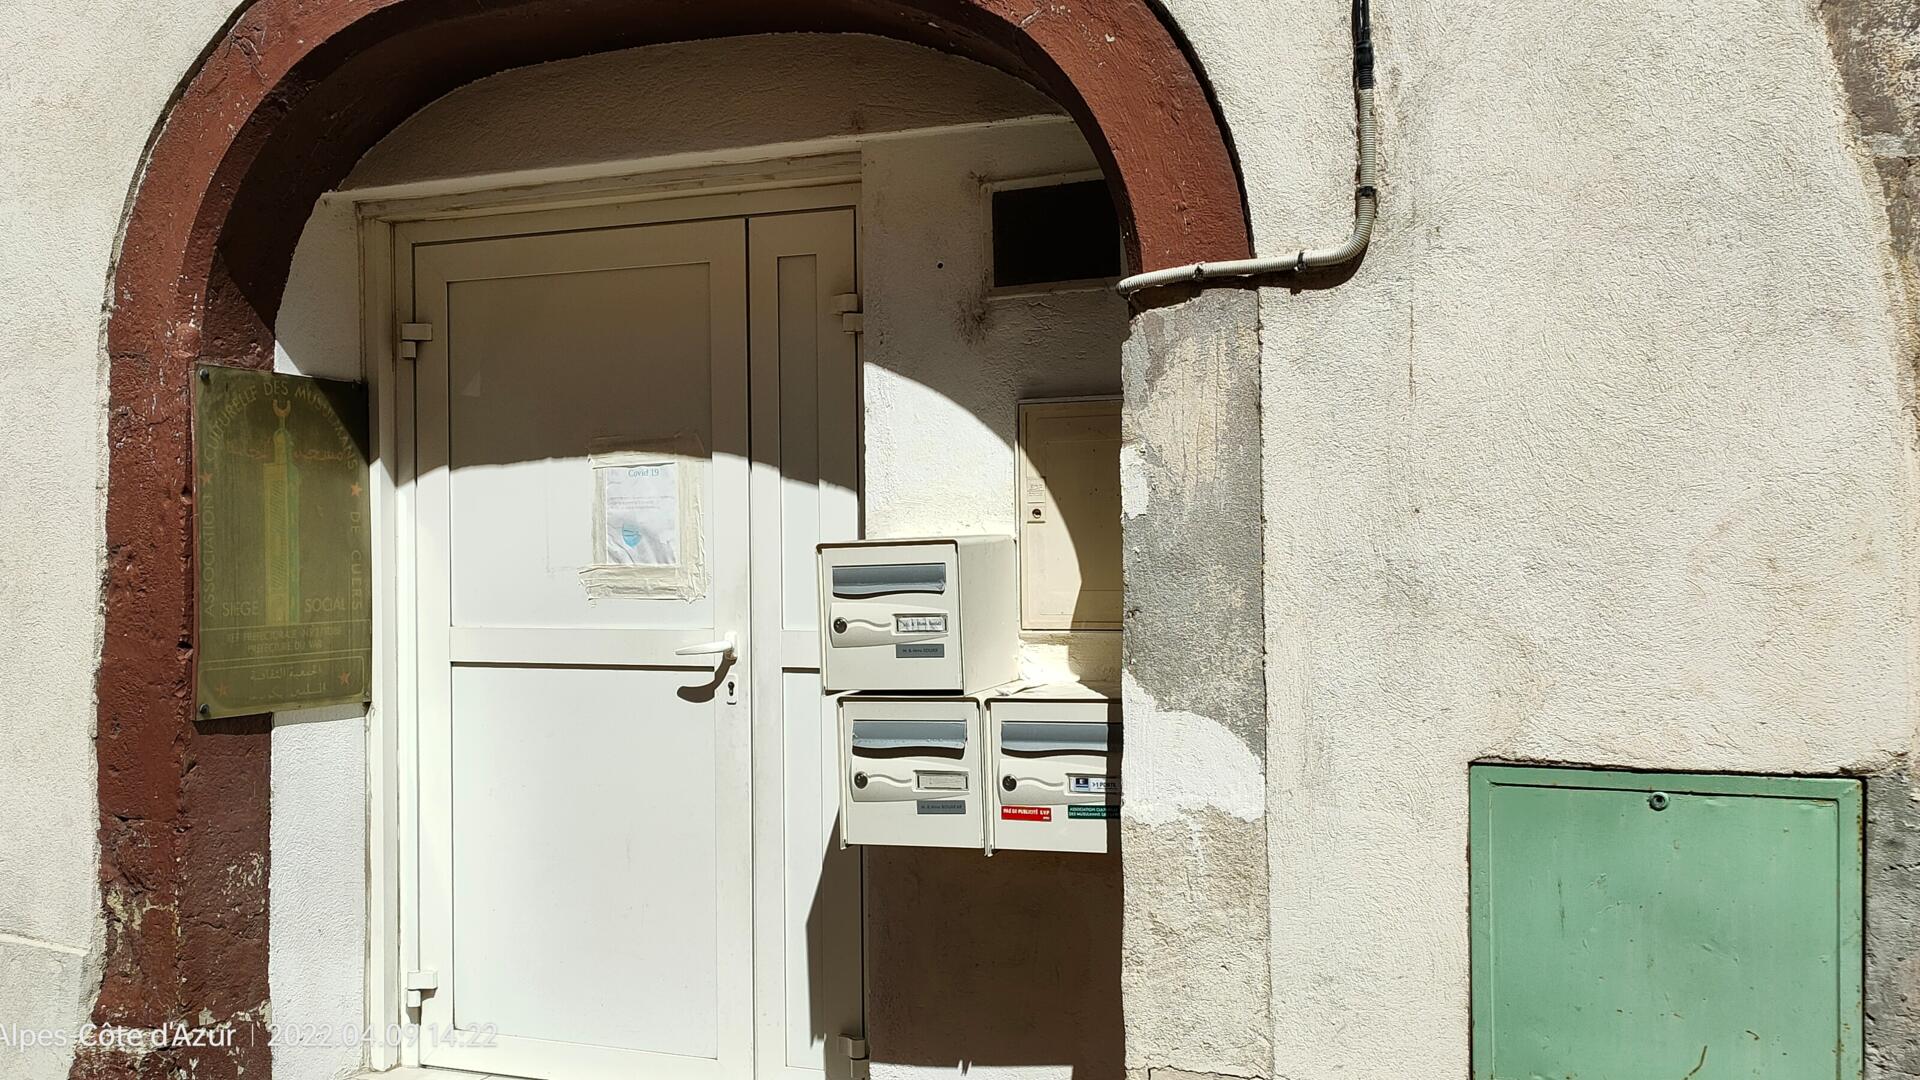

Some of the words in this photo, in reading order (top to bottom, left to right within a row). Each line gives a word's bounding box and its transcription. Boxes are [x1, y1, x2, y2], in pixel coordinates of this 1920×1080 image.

[263, 380, 289, 397] DES
[204, 384, 258, 463] CULTURELLE
[628, 467, 649, 478] Covid
[651, 467, 659, 477] 19
[351, 512, 361, 534] DE
[202, 495, 216, 617] ASSOCIATION
[351, 550, 362, 610] CUERS
[222, 600, 260, 617] SIEGE
[304, 597, 346, 613] SOCIAL
